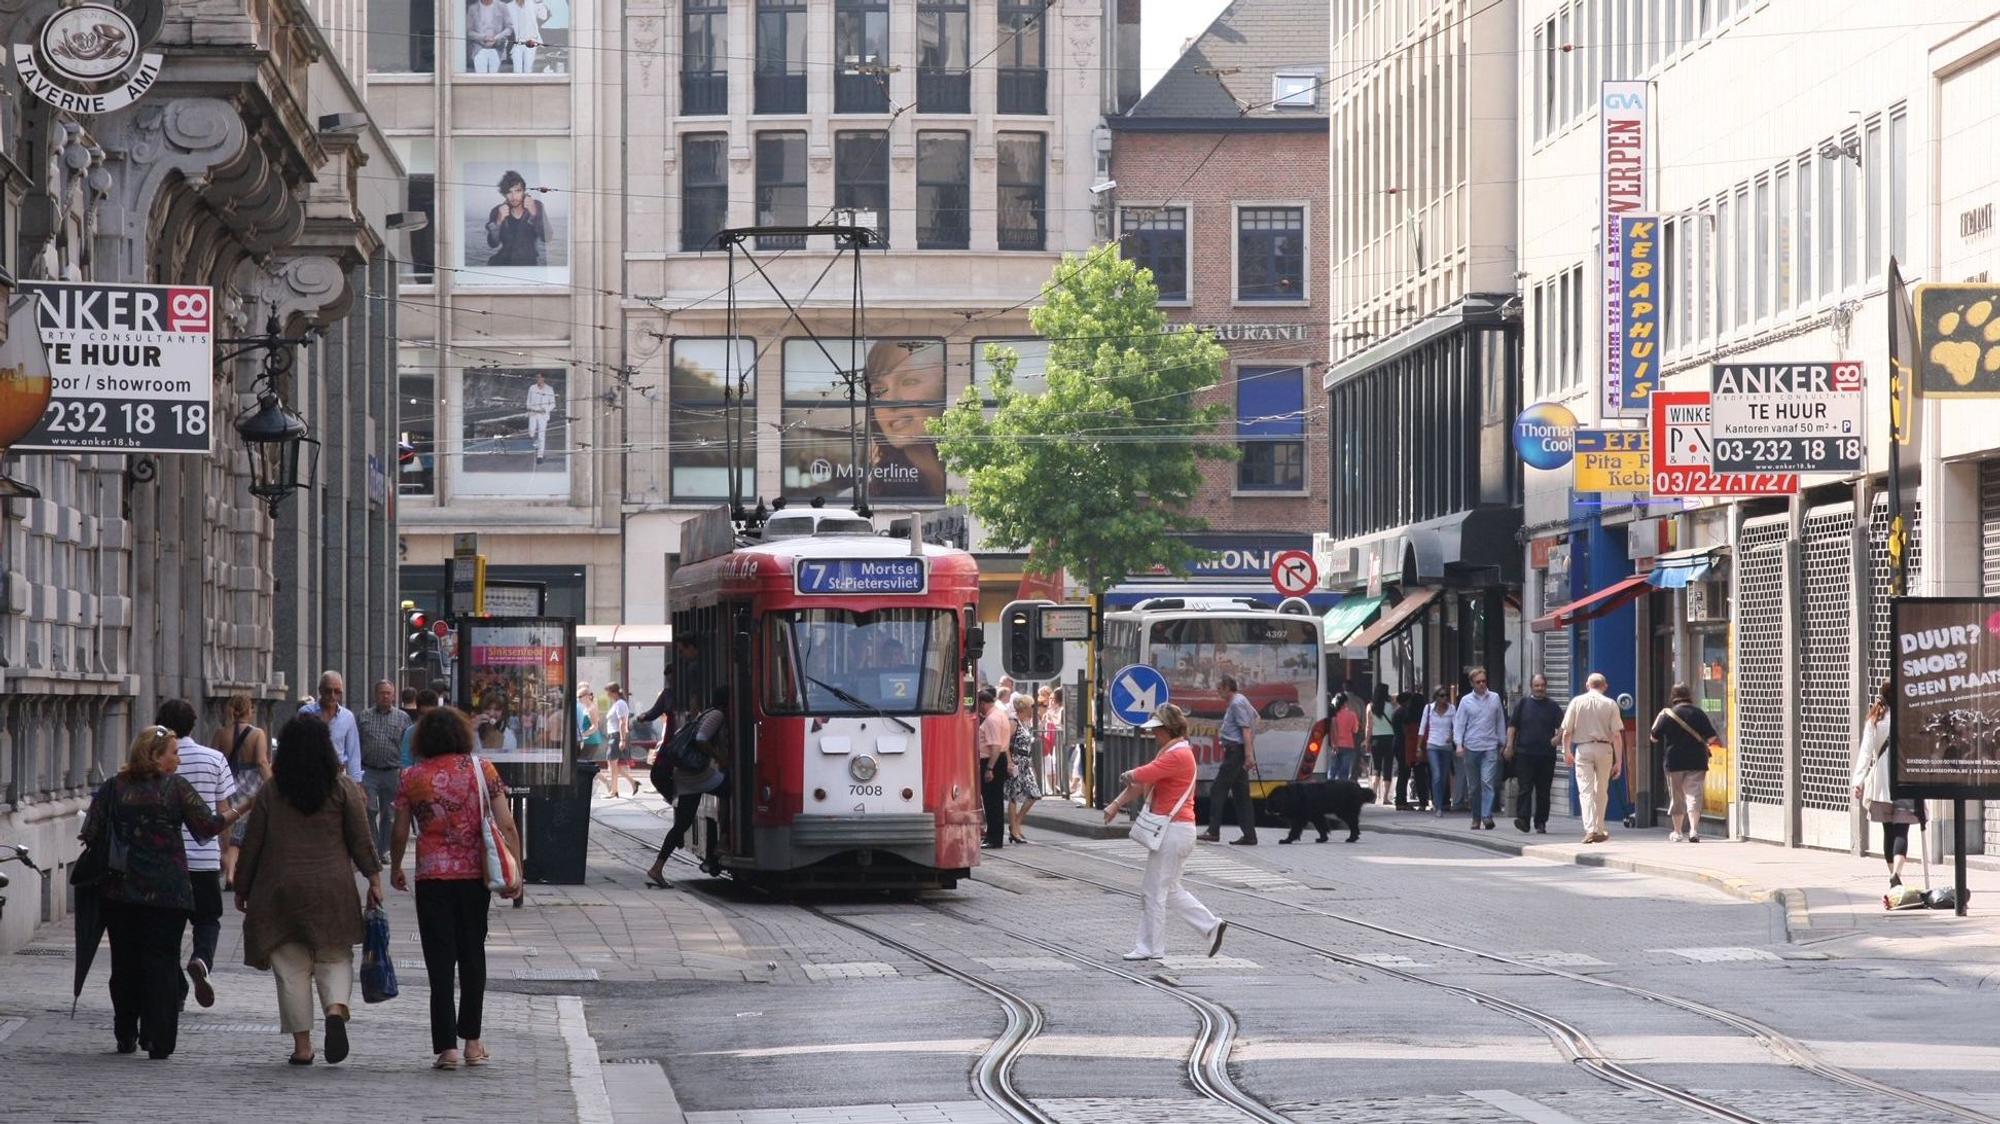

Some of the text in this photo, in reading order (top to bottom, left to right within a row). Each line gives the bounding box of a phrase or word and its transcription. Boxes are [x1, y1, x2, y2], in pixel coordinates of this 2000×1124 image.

[16, 54, 158, 112] TAVERNE AMI
[35, 288, 207, 333] NKER 18
[1629, 222, 1654, 399] KEBAPHUIS
[89, 333, 206, 344] CONSULTANTS
[1160, 324, 1307, 340] REAURANT
[81, 344, 161, 367] HUUR
[96, 377, 191, 392] showroom
[1717, 365, 1860, 393] ANKER 18
[47, 401, 206, 435] 232 18 18
[1748, 403, 1827, 419] TE HUUR
[1725, 424, 1769, 433] Kantoren
[1772, 423, 1797, 432] vanaf
[1801, 424, 1813, 432] 50
[51, 437, 141, 447] www.anker18.be
[1716, 439, 1860, 461] 03-232 18 18
[1585, 453, 1622, 469] Pita
[1196, 550, 1282, 569] MONI
[809, 562, 918, 589] 7 Mortsel
[1900, 624, 1980, 654] DUUR?
[1903, 652, 1967, 677] SNOB?
[1904, 678, 1946, 697] GEEN
[849, 785, 882, 796] 7008
